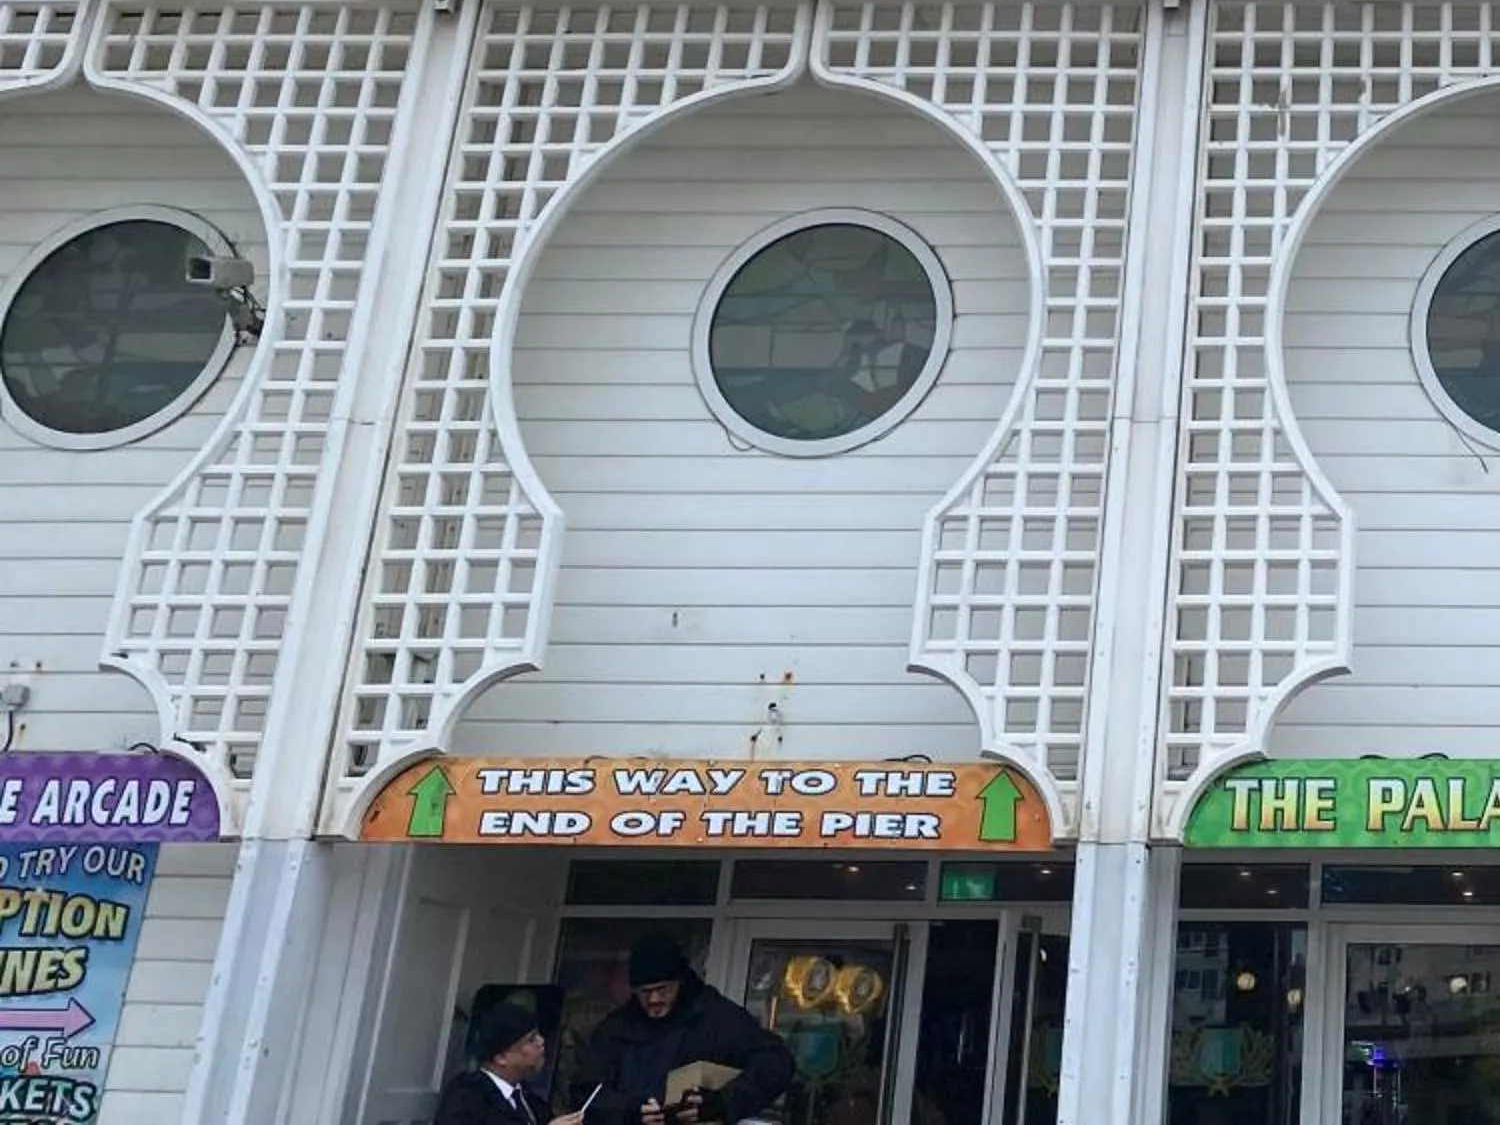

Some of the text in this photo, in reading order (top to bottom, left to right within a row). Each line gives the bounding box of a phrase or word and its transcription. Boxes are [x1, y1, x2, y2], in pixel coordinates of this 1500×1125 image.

[31, 778, 196, 825] ARCADE
[477, 768, 956, 797] THIS WAY TO THE
[1225, 776, 1338, 832] THE
[479, 810, 941, 839] END OF THE PIER
[19, 845, 78, 879] TRY
[82, 845, 146, 884] OUR
[0, 946, 89, 996] NES
[0, 1036, 100, 1072] of Fun
